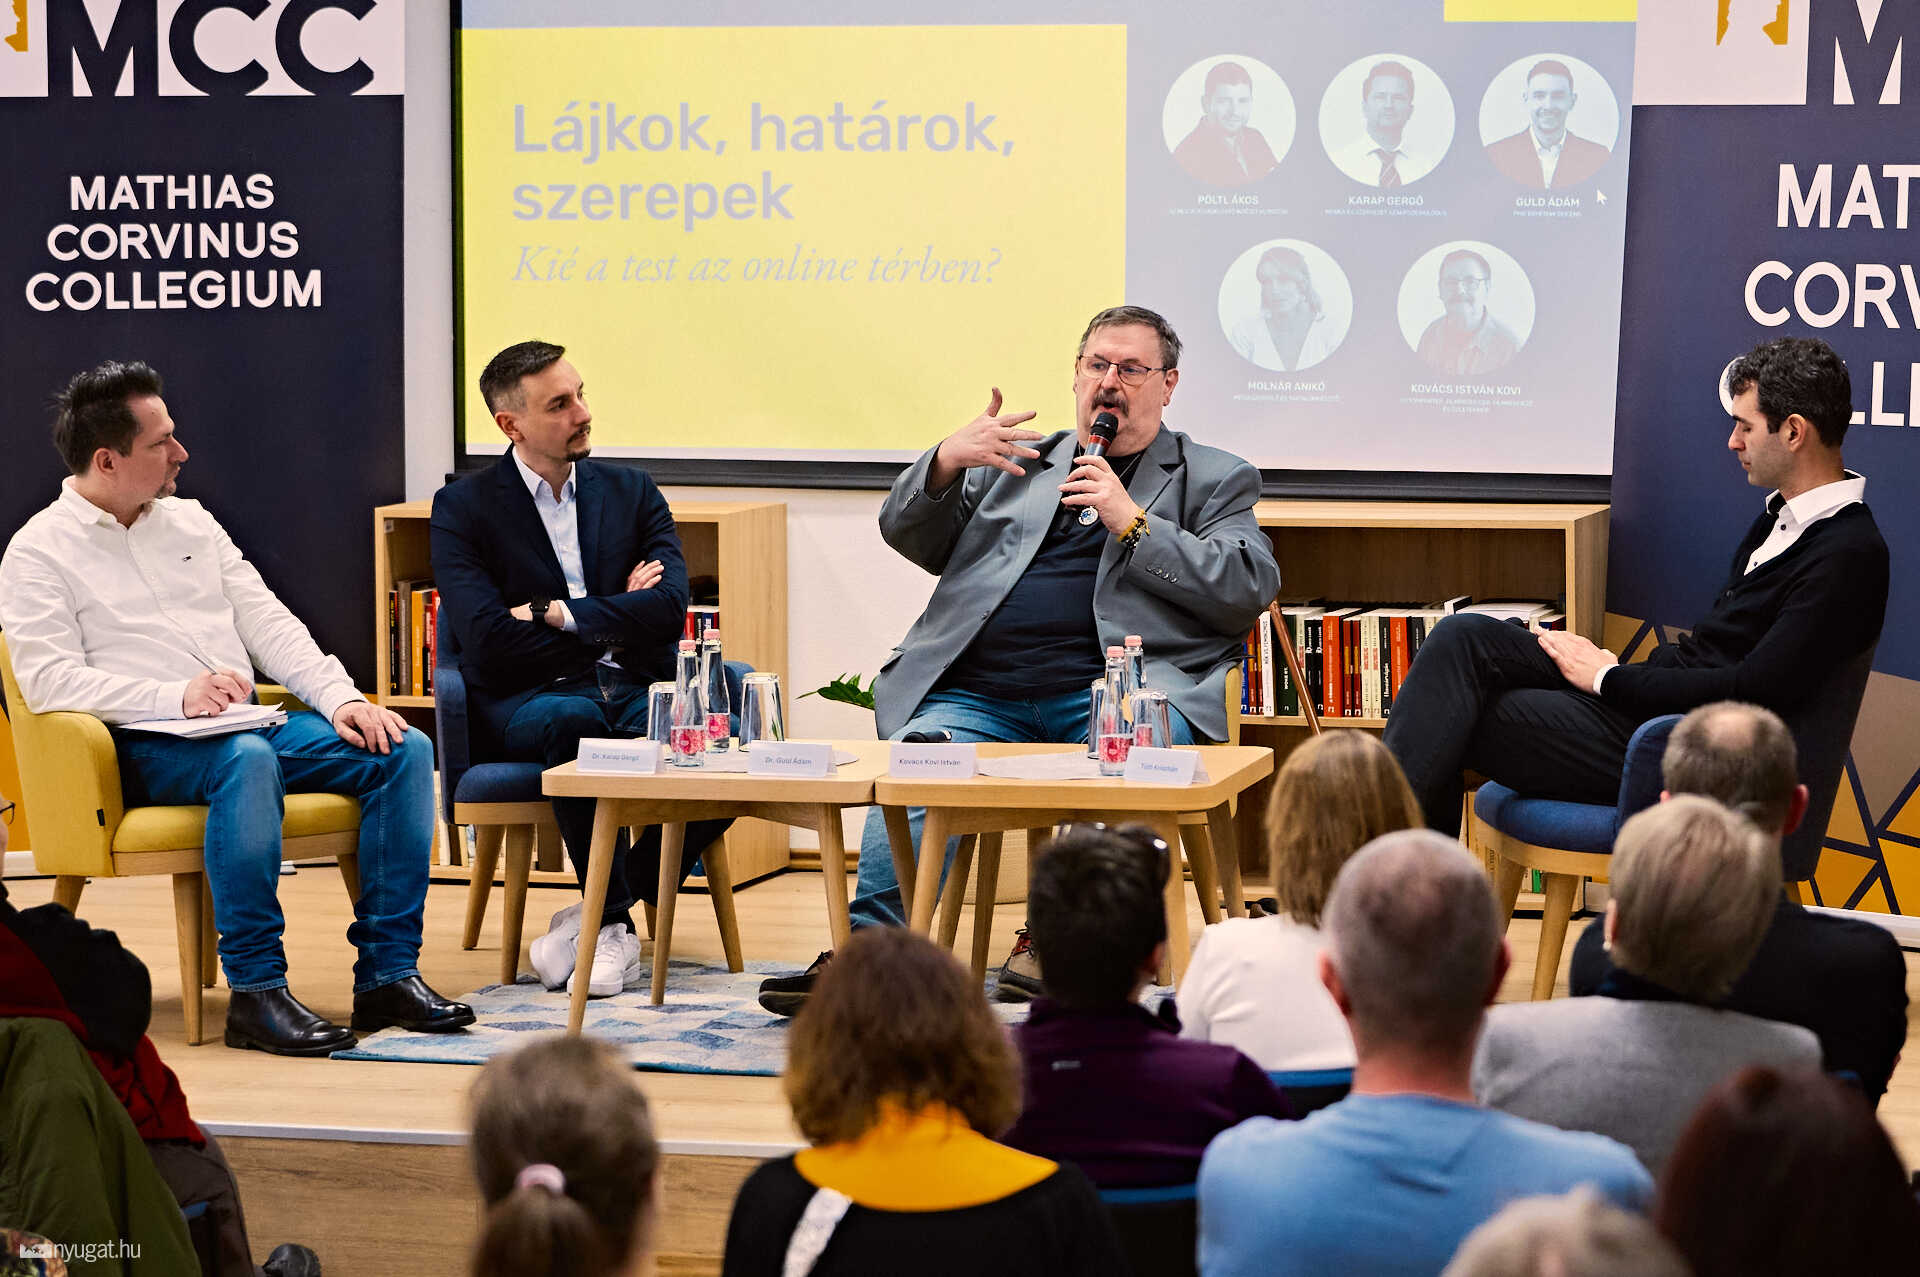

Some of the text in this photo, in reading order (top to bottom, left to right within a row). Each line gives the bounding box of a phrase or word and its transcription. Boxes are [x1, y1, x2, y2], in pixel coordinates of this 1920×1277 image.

[47, 0, 375, 97] MCC
[514, 100, 1015, 164] Lájkok, határok,
[70, 174, 275, 211] MATHIAS
[512, 170, 795, 232] szerepek
[47, 221, 299, 261] CORVINUS
[512, 243, 1002, 283] Kié a test az online térben?
[25, 269, 322, 312] COLLEGIUM
